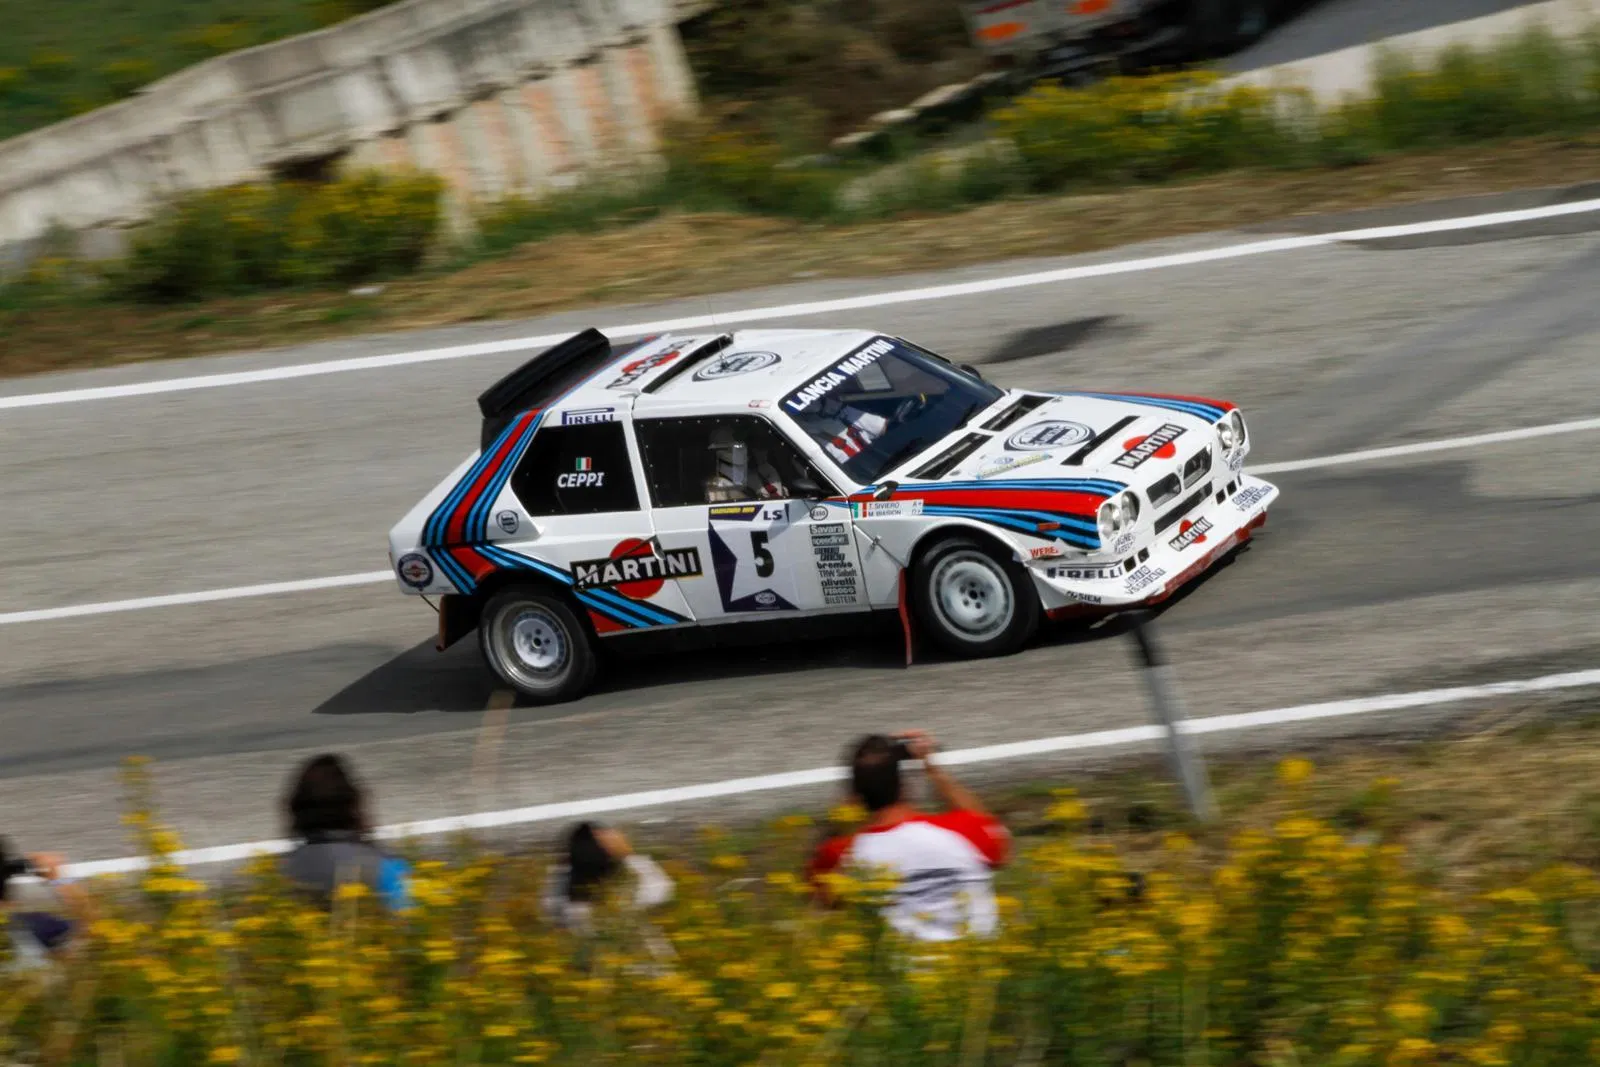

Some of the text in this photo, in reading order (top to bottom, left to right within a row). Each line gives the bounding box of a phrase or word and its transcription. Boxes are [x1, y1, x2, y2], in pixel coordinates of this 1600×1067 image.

[786, 339, 895, 411] LANCIA MARTINI
[561, 407, 615, 426] PIRELLI
[1117, 424, 1184, 469] MARTINI
[557, 472, 604, 488] CEPPI
[763, 510, 783, 521] LS
[1170, 516, 1212, 551] MARTINI
[576, 551, 698, 588] MARTINI
[750, 531, 775, 578] 5
[1046, 560, 1124, 579] PIRELLI
